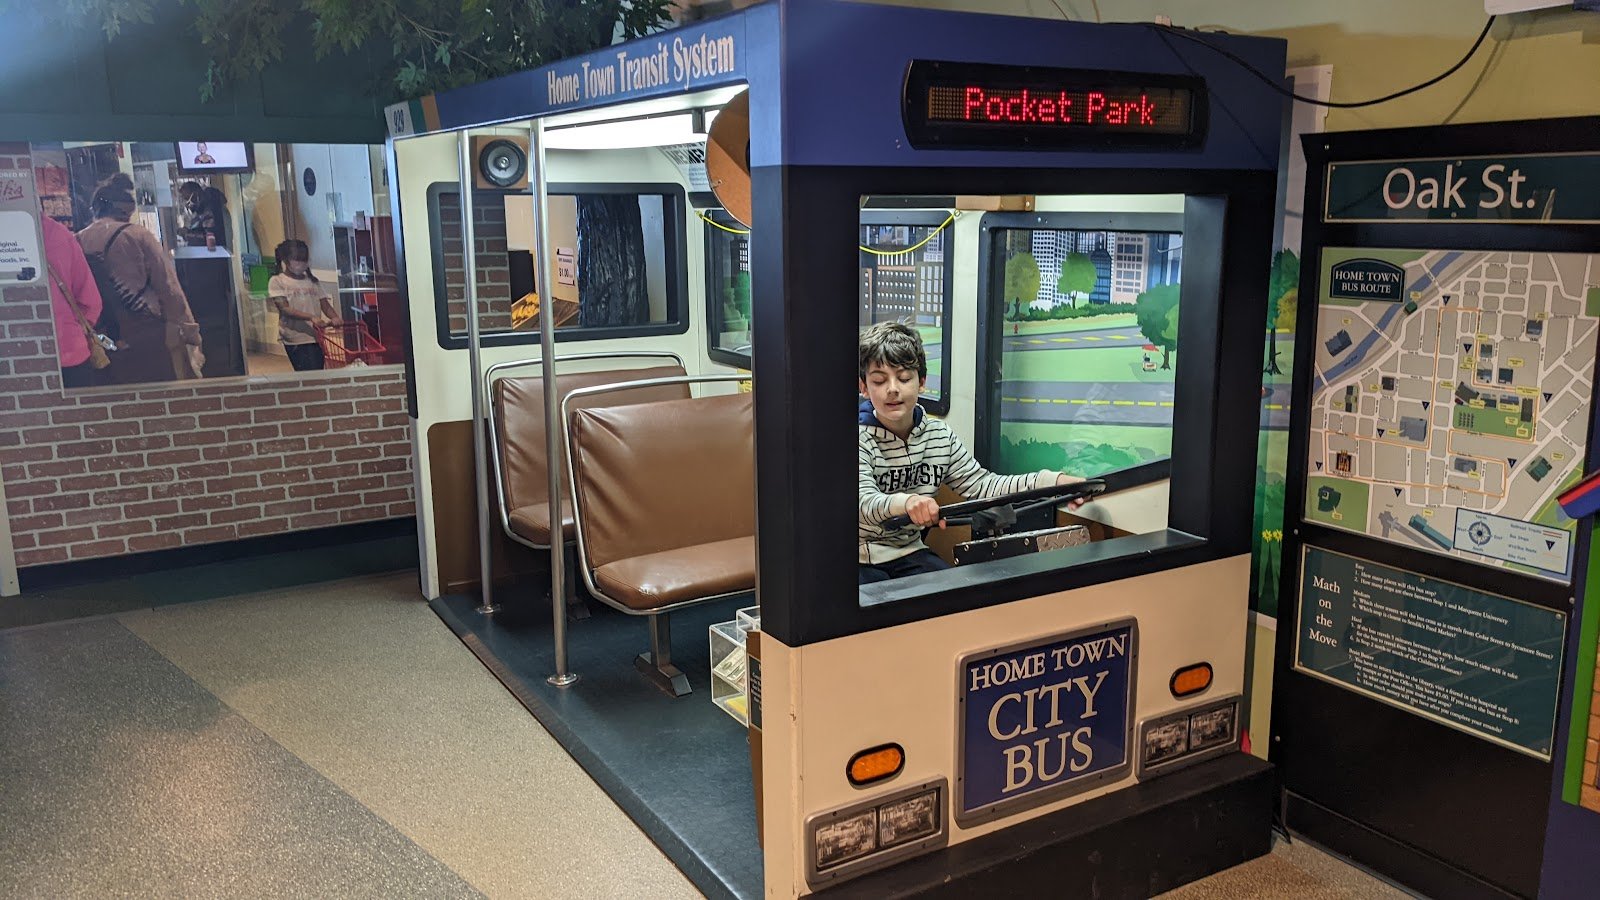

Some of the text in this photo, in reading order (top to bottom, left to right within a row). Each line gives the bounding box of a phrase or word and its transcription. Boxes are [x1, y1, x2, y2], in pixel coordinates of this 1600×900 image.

[547, 32, 735, 106] Home Town Transit System
[964, 86, 1154, 125] Pocket Park
[1382, 163, 1535, 210] Oak St.
[1335, 270, 1400, 282] HOME TOWN
[1342, 282, 1391, 294] BUS ROUTE
[1313, 575, 1341, 594] Math
[1318, 598, 1332, 610] on
[1359, 604, 1373, 613] Which
[1426, 624, 1437, 632] Food
[1316, 612, 1333, 628] the
[1359, 598, 1373, 607] Which
[1475, 632, 1489, 641] Cedar
[1511, 642, 1535, 654] Sycamore
[1482, 612, 1508, 625] University
[1309, 628, 1338, 648] Move
[969, 633, 1127, 692] HOME TOWN
[988, 671, 1109, 741] CITY
[1001, 726, 1093, 793] BUS
